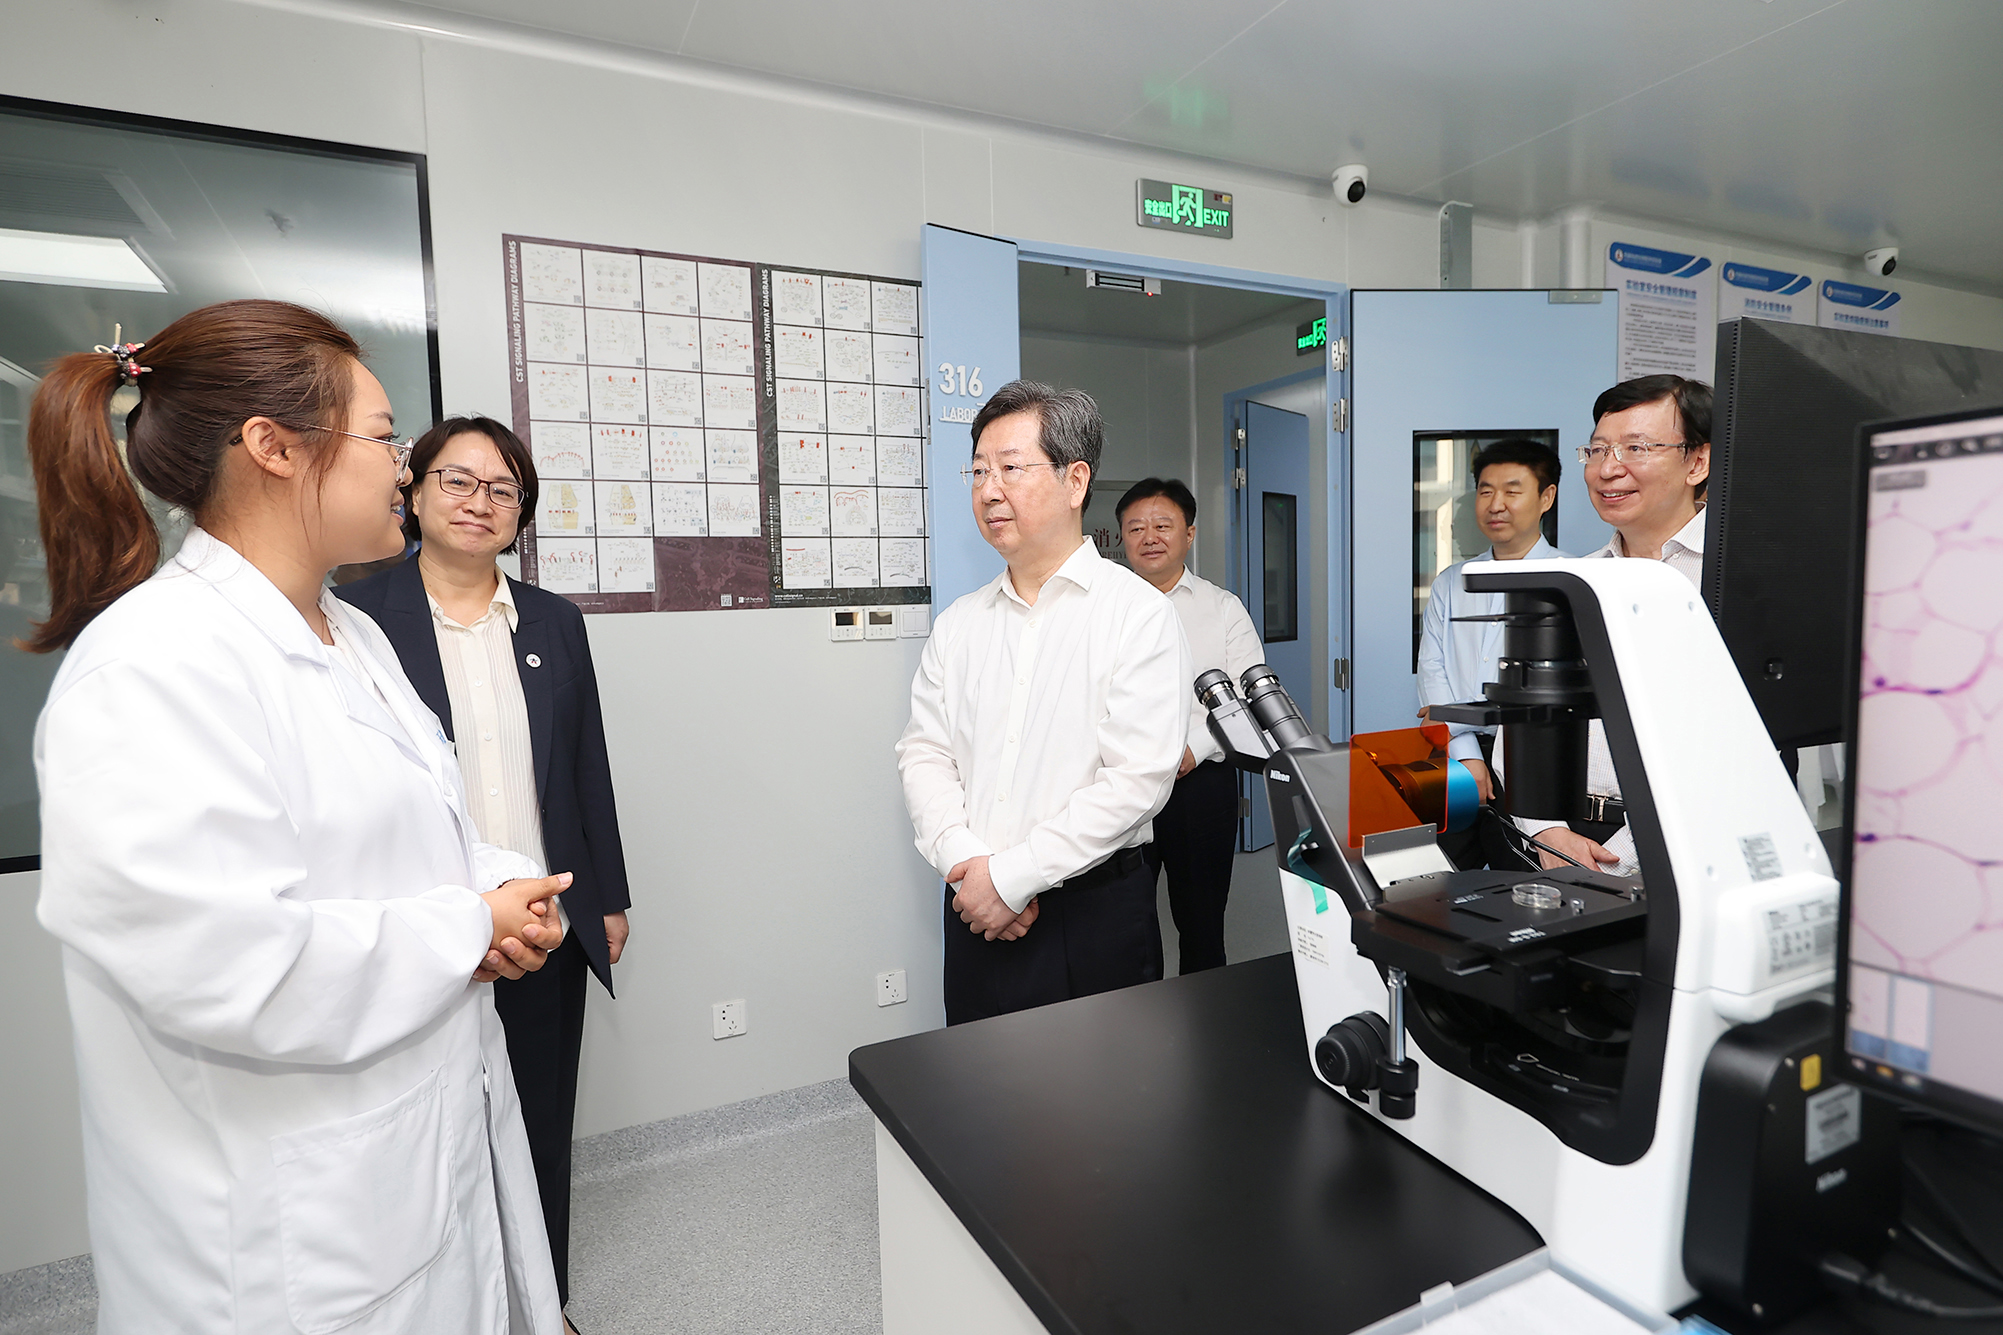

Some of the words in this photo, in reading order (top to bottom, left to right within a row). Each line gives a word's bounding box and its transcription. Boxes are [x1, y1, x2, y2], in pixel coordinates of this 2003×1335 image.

[1203, 208, 1230, 227] EXIT
[509, 240, 518, 283] DIAGRAMS
[511, 284, 520, 322] PATHWAY
[763, 308, 771, 342] PATHWAY
[513, 323, 523, 366] SIGNALING
[764, 343, 773, 382] SIGNALING
[516, 367, 524, 382] CST
[939, 362, 983, 398] 316
[1270, 769, 1290, 783] Nikon
